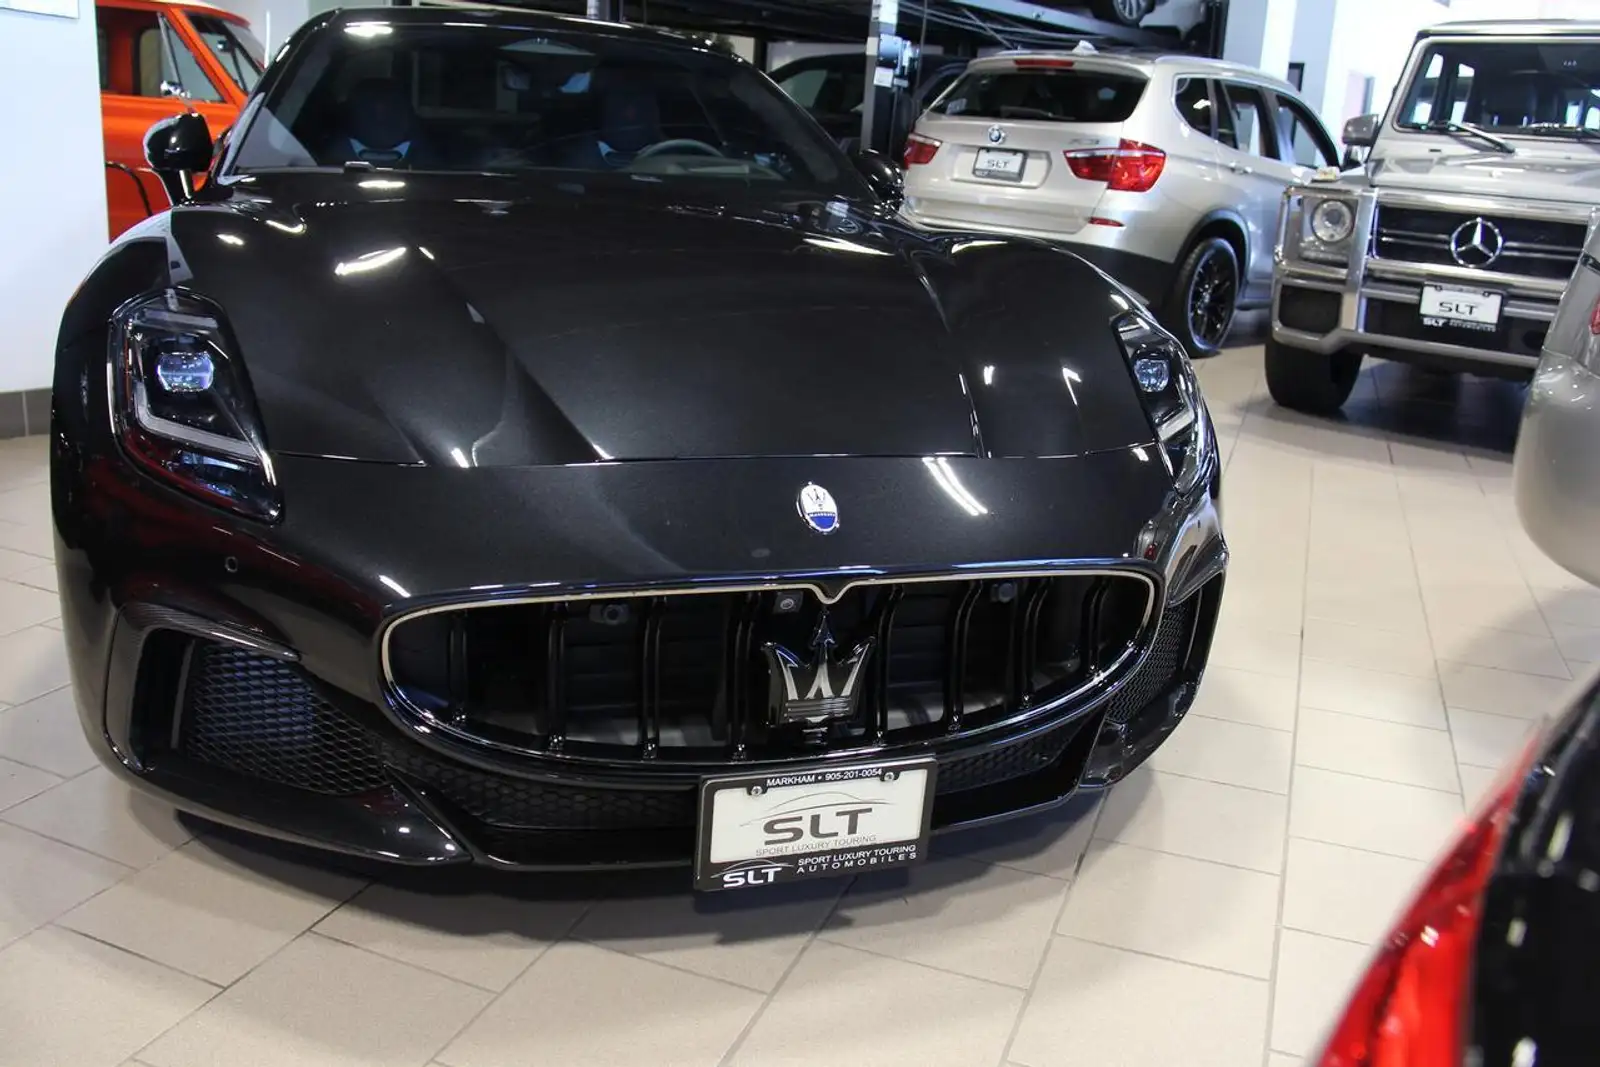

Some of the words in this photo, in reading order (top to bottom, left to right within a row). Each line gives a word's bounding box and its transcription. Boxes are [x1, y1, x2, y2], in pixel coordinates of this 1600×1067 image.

[1439, 301, 1478, 315] SLT
[766, 775, 815, 787] MARKHAM
[825, 768, 882, 781] 905-201-0054
[763, 808, 872, 845] SLT
[755, 846, 789, 857] SPORT
[792, 840, 831, 852] LUXURY
[832, 835, 877, 848] TOURING
[797, 856, 831, 866] SPORT
[833, 850, 872, 862] LUXURY
[874, 844, 917, 856] TOURING
[796, 852, 917, 874] AUTOMOBILES
[723, 867, 782, 888] SLT
